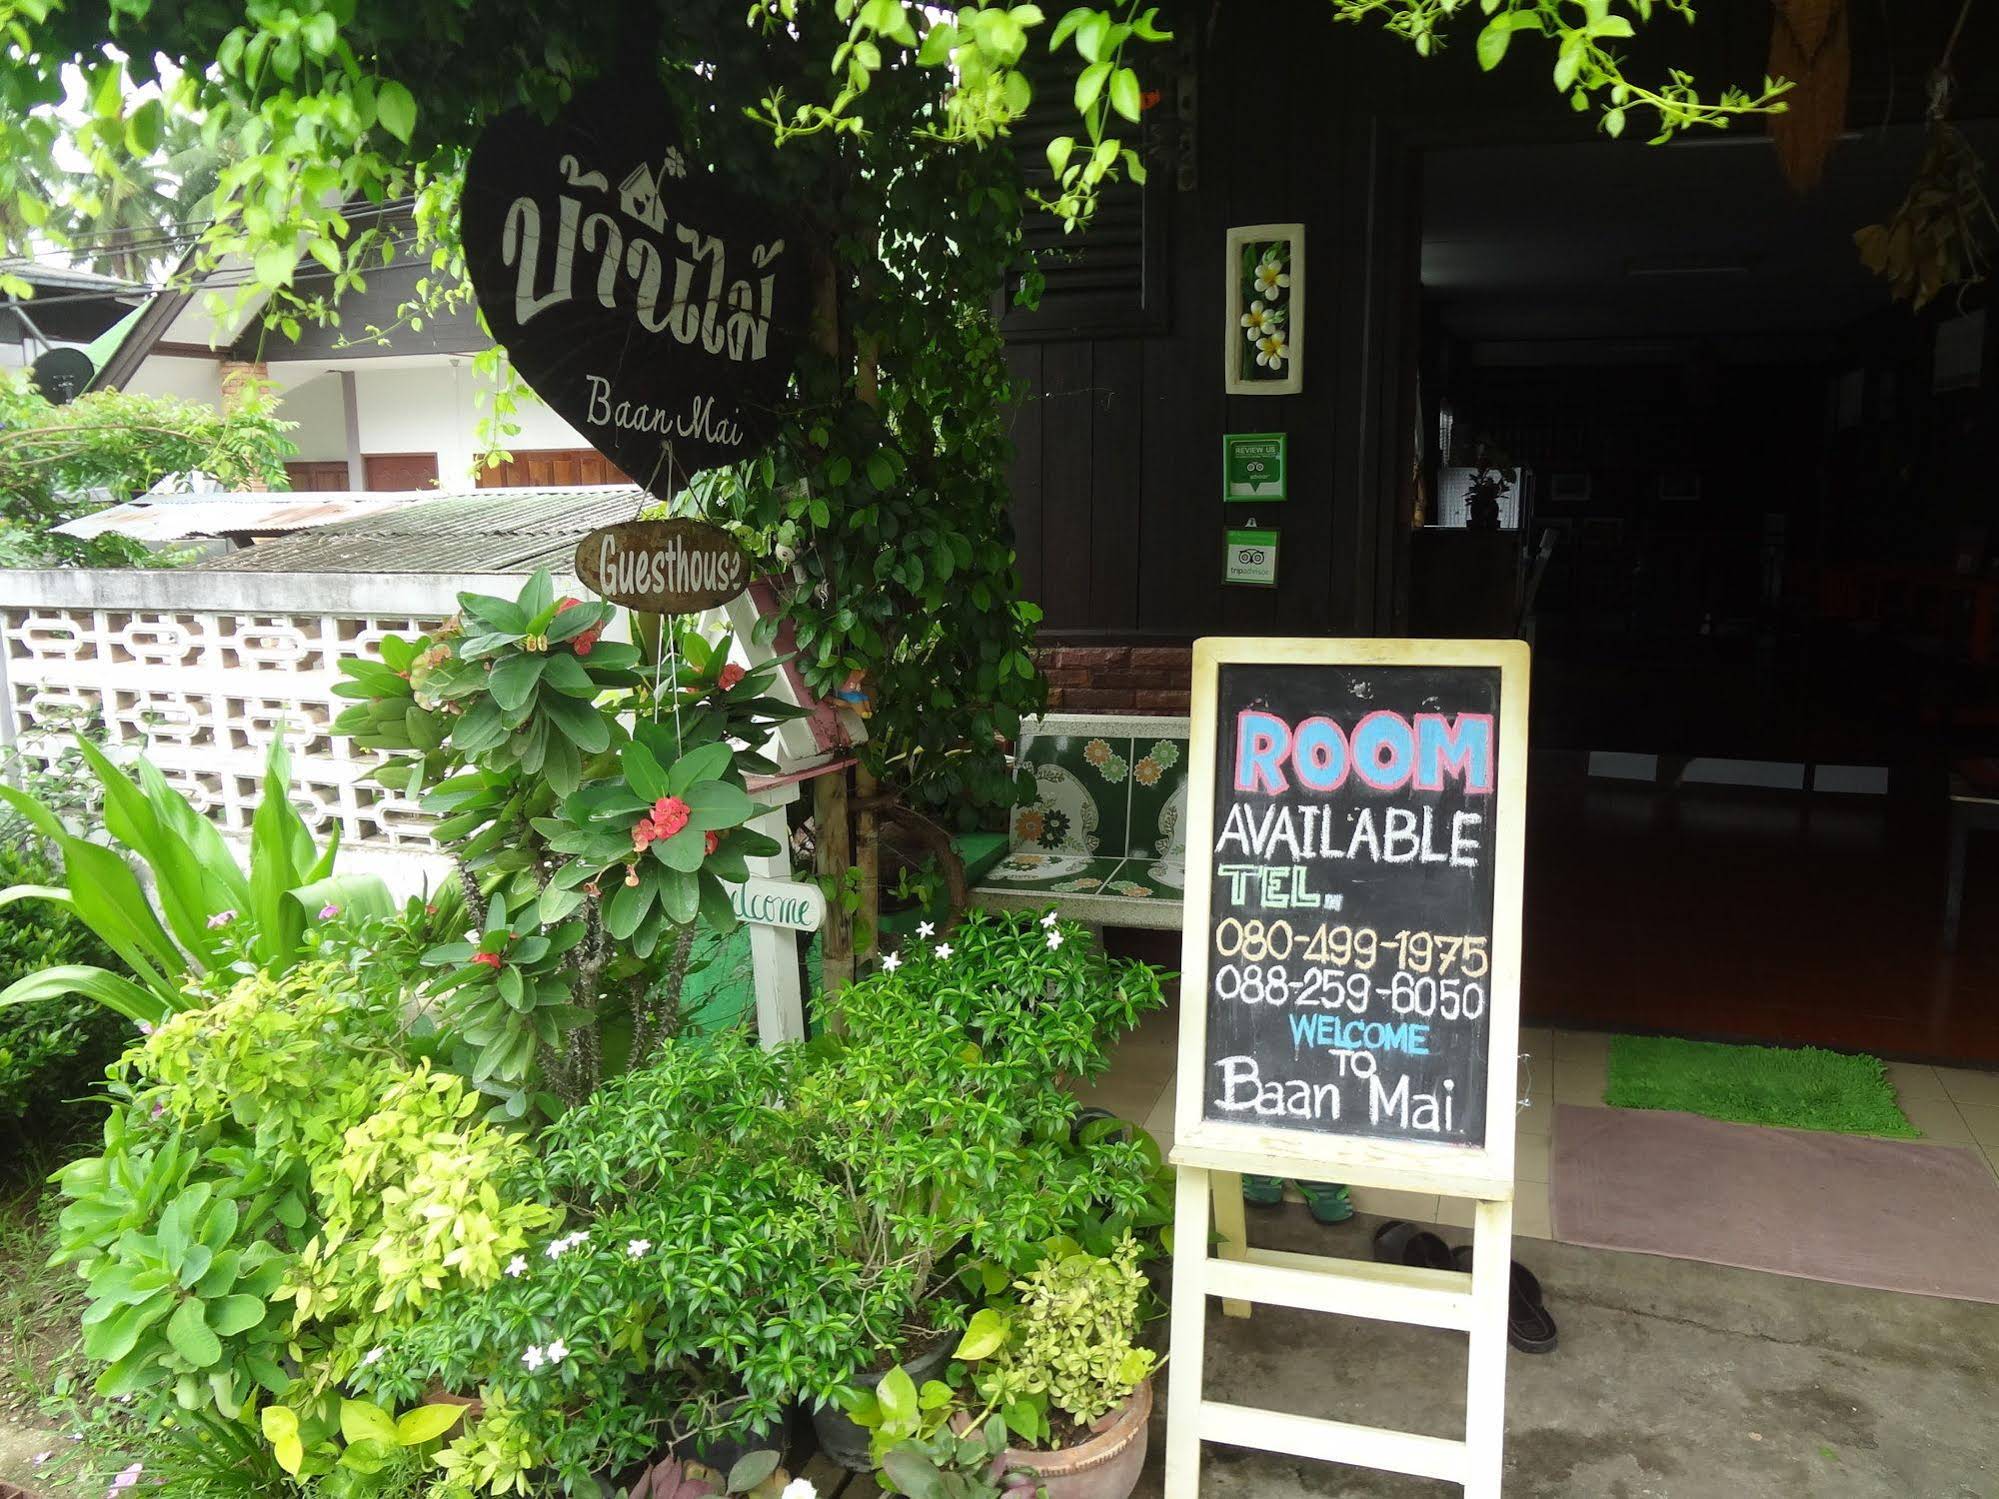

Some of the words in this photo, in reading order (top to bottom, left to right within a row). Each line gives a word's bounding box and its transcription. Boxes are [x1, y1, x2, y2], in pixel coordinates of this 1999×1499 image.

[502, 154, 785, 362] บ้านไม้
[586, 374, 674, 435] Baan
[676, 395, 743, 446] Mai
[1234, 709, 1494, 796] ROOM
[1214, 802, 1483, 868] AVAILABLE
[1215, 917, 1488, 977] 080-499-1975
[1215, 964, 1485, 1020] 088-259-6050
[1288, 1012, 1430, 1055] WELCOME
[1328, 1049, 1377, 1078] TO
[1213, 1055, 1341, 1120] Baan
[1369, 1073, 1454, 1132] Mai
